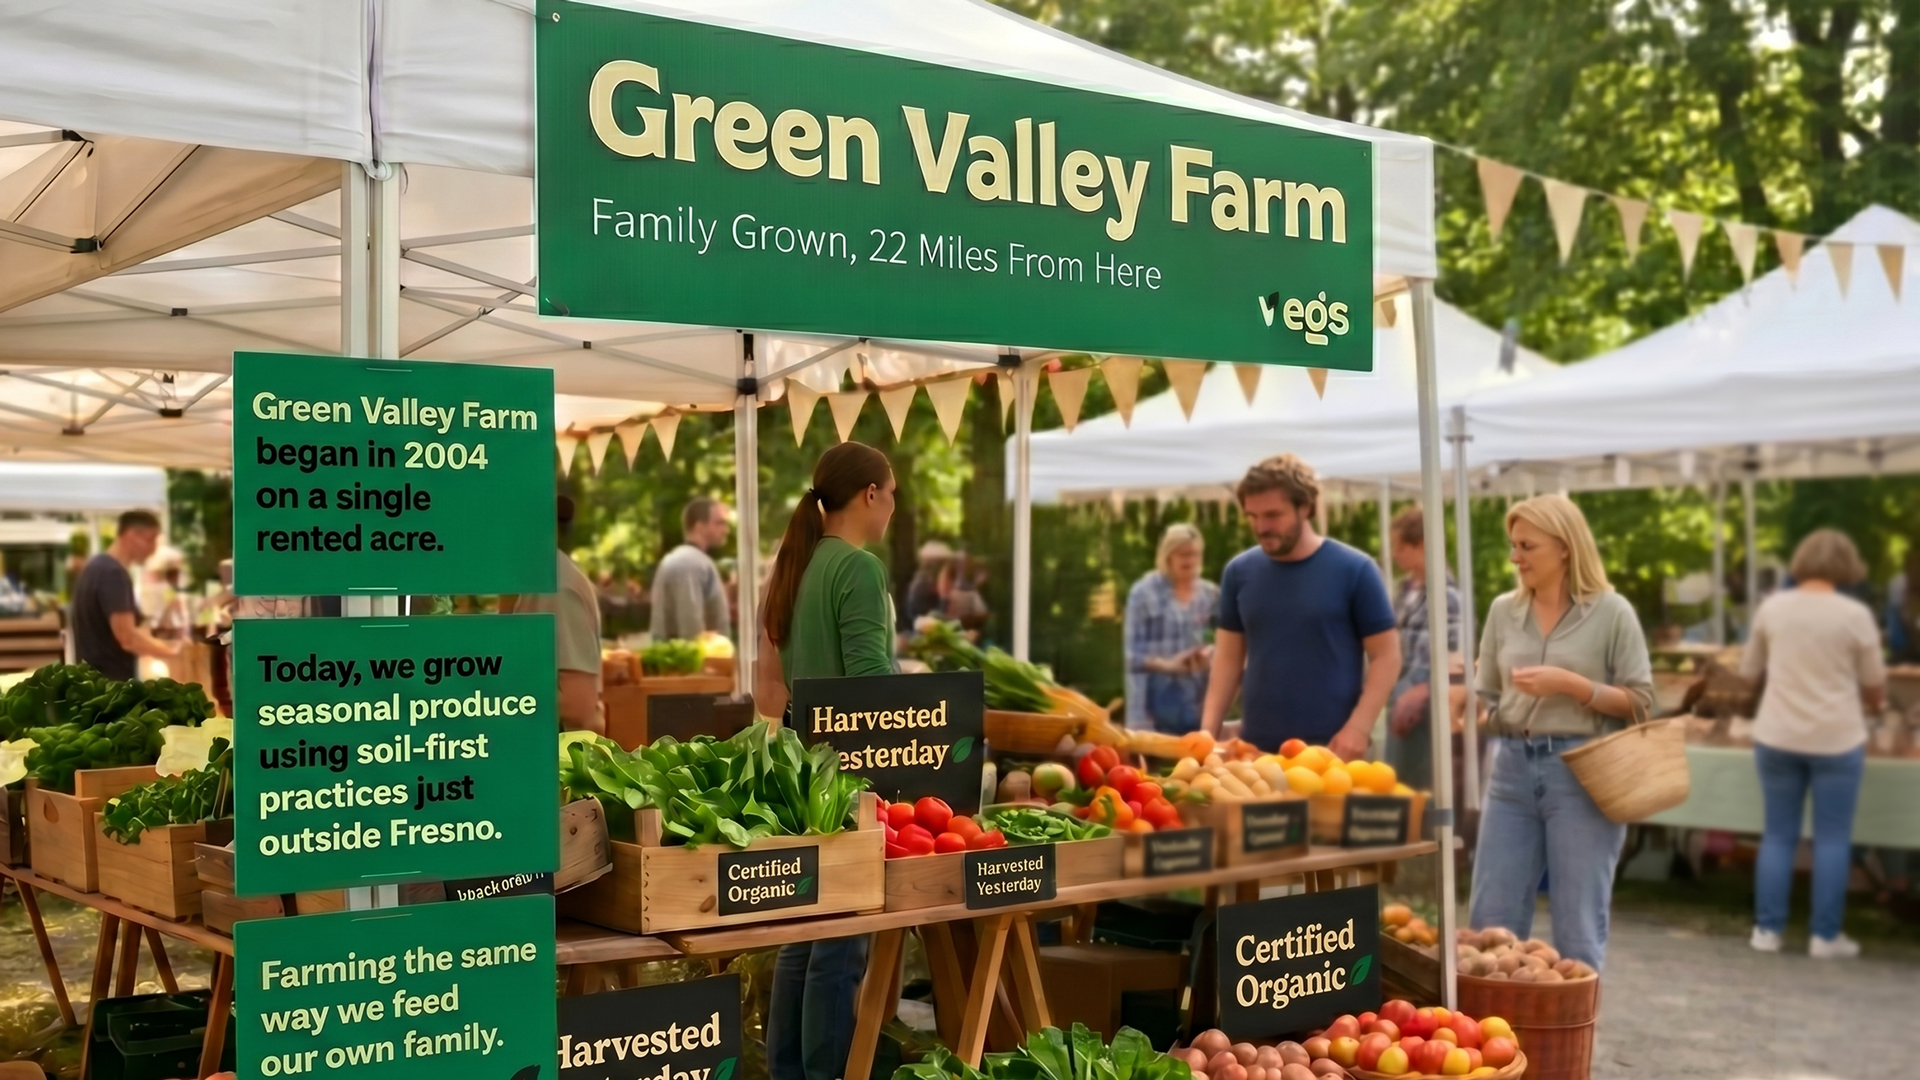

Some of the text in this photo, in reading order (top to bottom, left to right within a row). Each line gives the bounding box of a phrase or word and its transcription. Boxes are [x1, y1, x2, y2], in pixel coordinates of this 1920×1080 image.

[589, 60, 1346, 244] Green Valley Farm
[593, 197, 1162, 289] Family Grown, 22 Miles From Here
[252, 391, 538, 434] Green Valley Farm
[256, 436, 489, 473] began in 2004
[256, 482, 432, 518] on a single
[256, 523, 444, 552] rented acre.
[257, 653, 503, 688] Today, we grow
[258, 690, 537, 727] seasonal produce
[812, 700, 948, 734] Harvested
[259, 732, 489, 773] using soil-first
[838, 738, 950, 771] esterday
[259, 775, 475, 820] practices just
[259, 818, 503, 856] outside Fresno.
[728, 857, 801, 882] Certified
[976, 855, 1044, 877] Harvested
[728, 880, 796, 905] Organic
[976, 876, 1042, 897] Yesterday
[1235, 918, 1356, 967] Certified
[260, 940, 537, 990] Farming the same
[1235, 960, 1346, 1010] Organic
[260, 984, 460, 1037] way we feed
[260, 1022, 504, 1077] our own family.
[557, 1010, 722, 1070] Harvested
